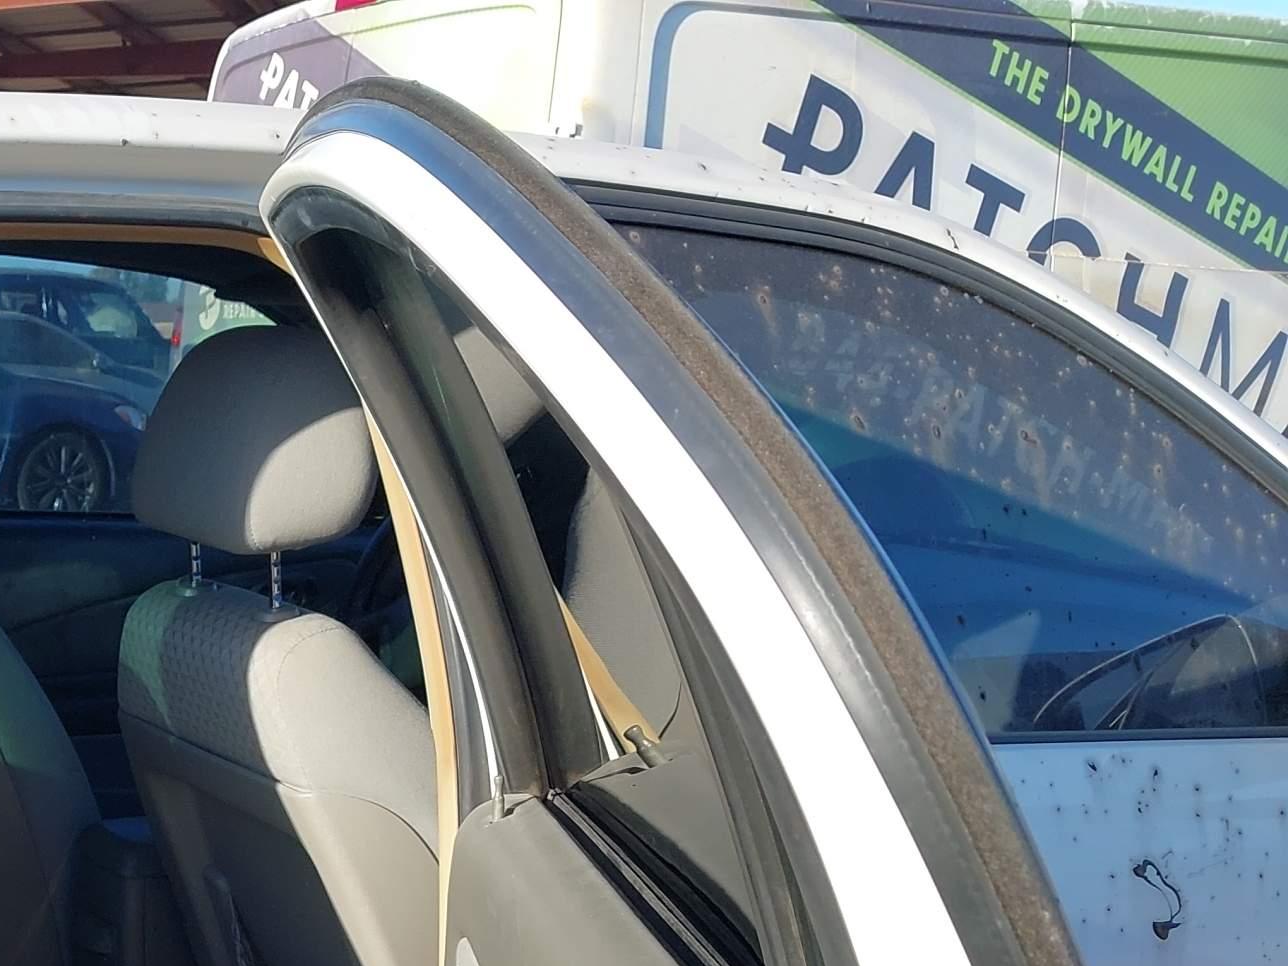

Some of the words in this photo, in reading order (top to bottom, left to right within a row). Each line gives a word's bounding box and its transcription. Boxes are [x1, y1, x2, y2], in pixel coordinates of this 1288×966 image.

[989, 38, 1050, 106] THE
[1055, 84, 1198, 203] DRYWALL
[1205, 180, 1288, 265] REPAI
